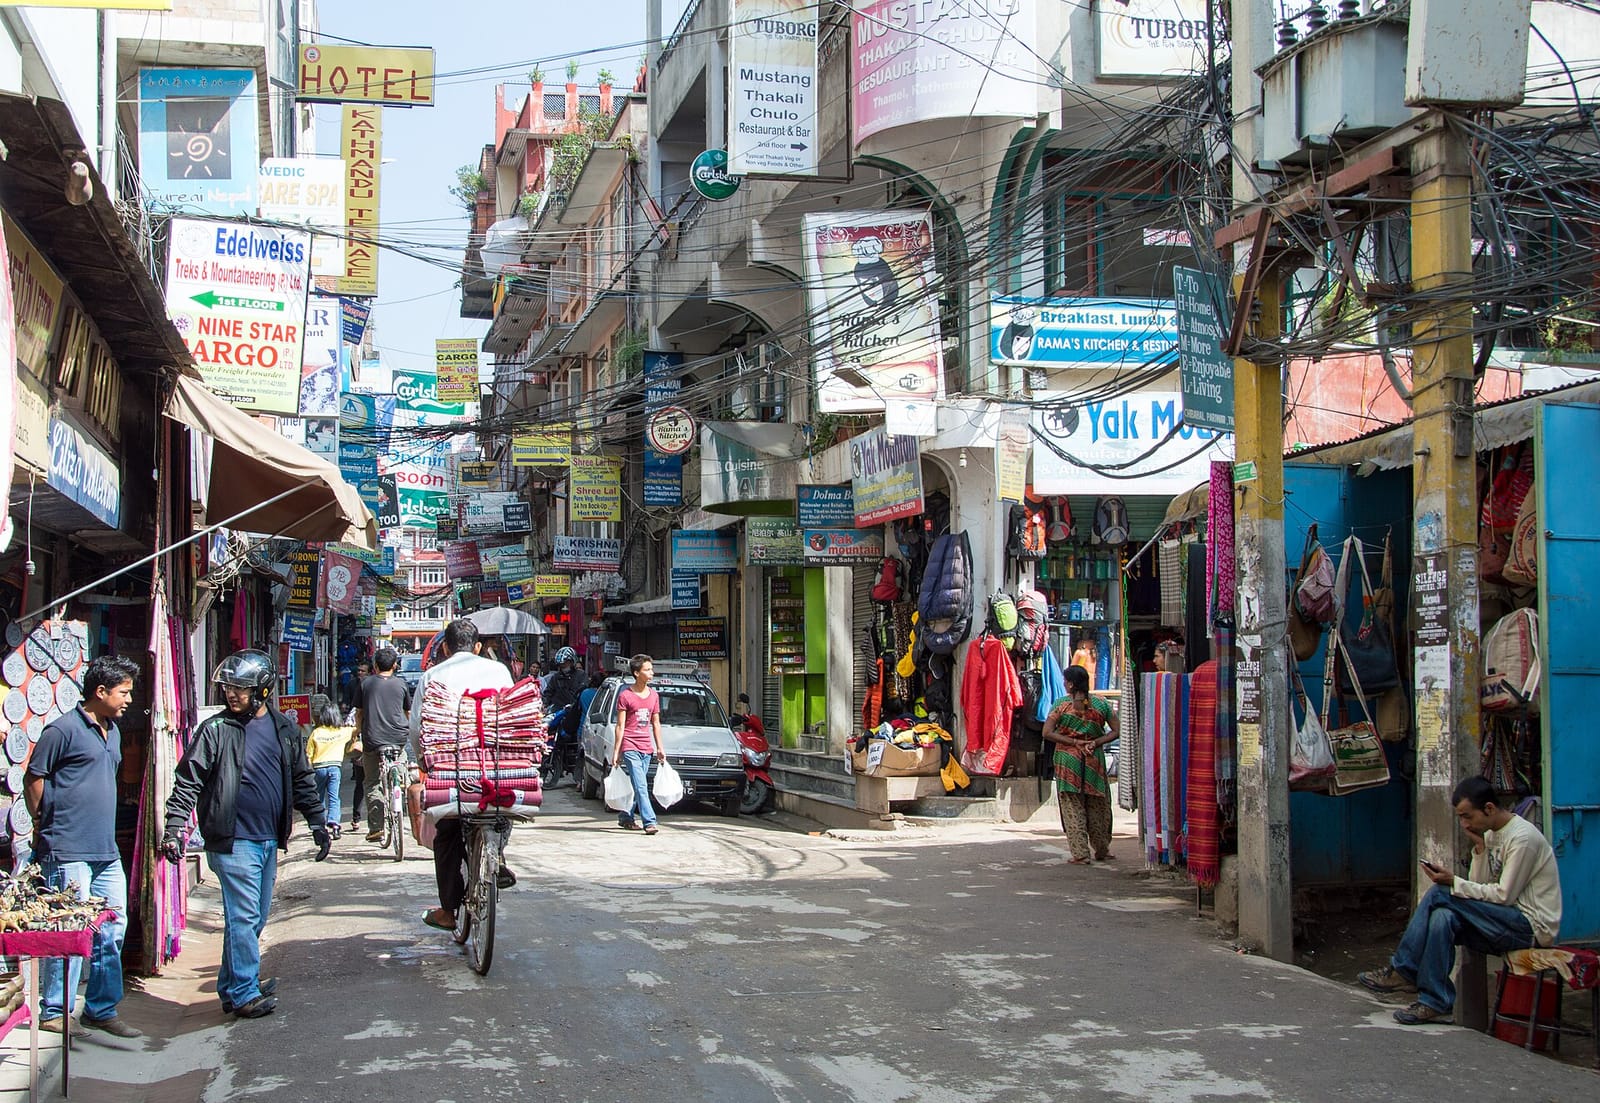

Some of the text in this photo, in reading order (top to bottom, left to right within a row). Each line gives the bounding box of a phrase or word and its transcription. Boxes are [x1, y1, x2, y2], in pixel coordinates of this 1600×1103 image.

[753, 18, 816, 38] TUBORG
[859, 35, 926, 69] THAKALI
[301, 64, 430, 100] HOTEL
[740, 68, 811, 88] Mustang
[858, 54, 950, 96] RESUAURANT
[744, 89, 803, 105] Thakali
[750, 107, 798, 121] Chulo
[739, 122, 811, 138] Restaurant & Bar
[350, 109, 375, 199] KATHMANDU
[260, 182, 338, 206] ARE SPA
[215, 227, 304, 263] Edelweiss
[175, 258, 199, 281] Treks
[201, 261, 208, 281] &
[210, 262, 276, 292] Mountaineering
[289, 274, 303, 292] Ltd.
[217, 296, 278, 311] 1st FLOOR
[1121, 313, 1166, 327] Lunch
[198, 316, 297, 344] NINE STAR
[842, 334, 900, 349] Kitchen
[1037, 336, 1140, 351] RAMA'S KITCHEN &
[436, 352, 478, 361] CARGO
[217, 366, 244, 376] Freight
[245, 367, 287, 380] Forwarders
[437, 375, 459, 383] FedEx
[1086, 400, 1139, 444] Yak
[573, 457, 593, 466] Shree
[861, 431, 917, 482] Yak Mountain
[725, 458, 765, 473] Cuisine
[396, 471, 444, 487] soon
[576, 487, 617, 495] Shree Lal
[813, 490, 841, 500] Dolma
[467, 505, 485, 516] TIBET
[569, 539, 619, 550] KRISHNA
[828, 532, 853, 544] Yak
[360, 550, 374, 560] Spa
[556, 548, 619, 559] WOOL CENTRE
[828, 546, 881, 555] mountain
[823, 556, 837, 564] buy,
[294, 565, 310, 574] EAK
[536, 576, 551, 584] Shree
[553, 576, 561, 584] Lal
[1415, 570, 1447, 585] SILENCE
[290, 589, 312, 598] OUSE
[652, 686, 706, 697] UZUKI
